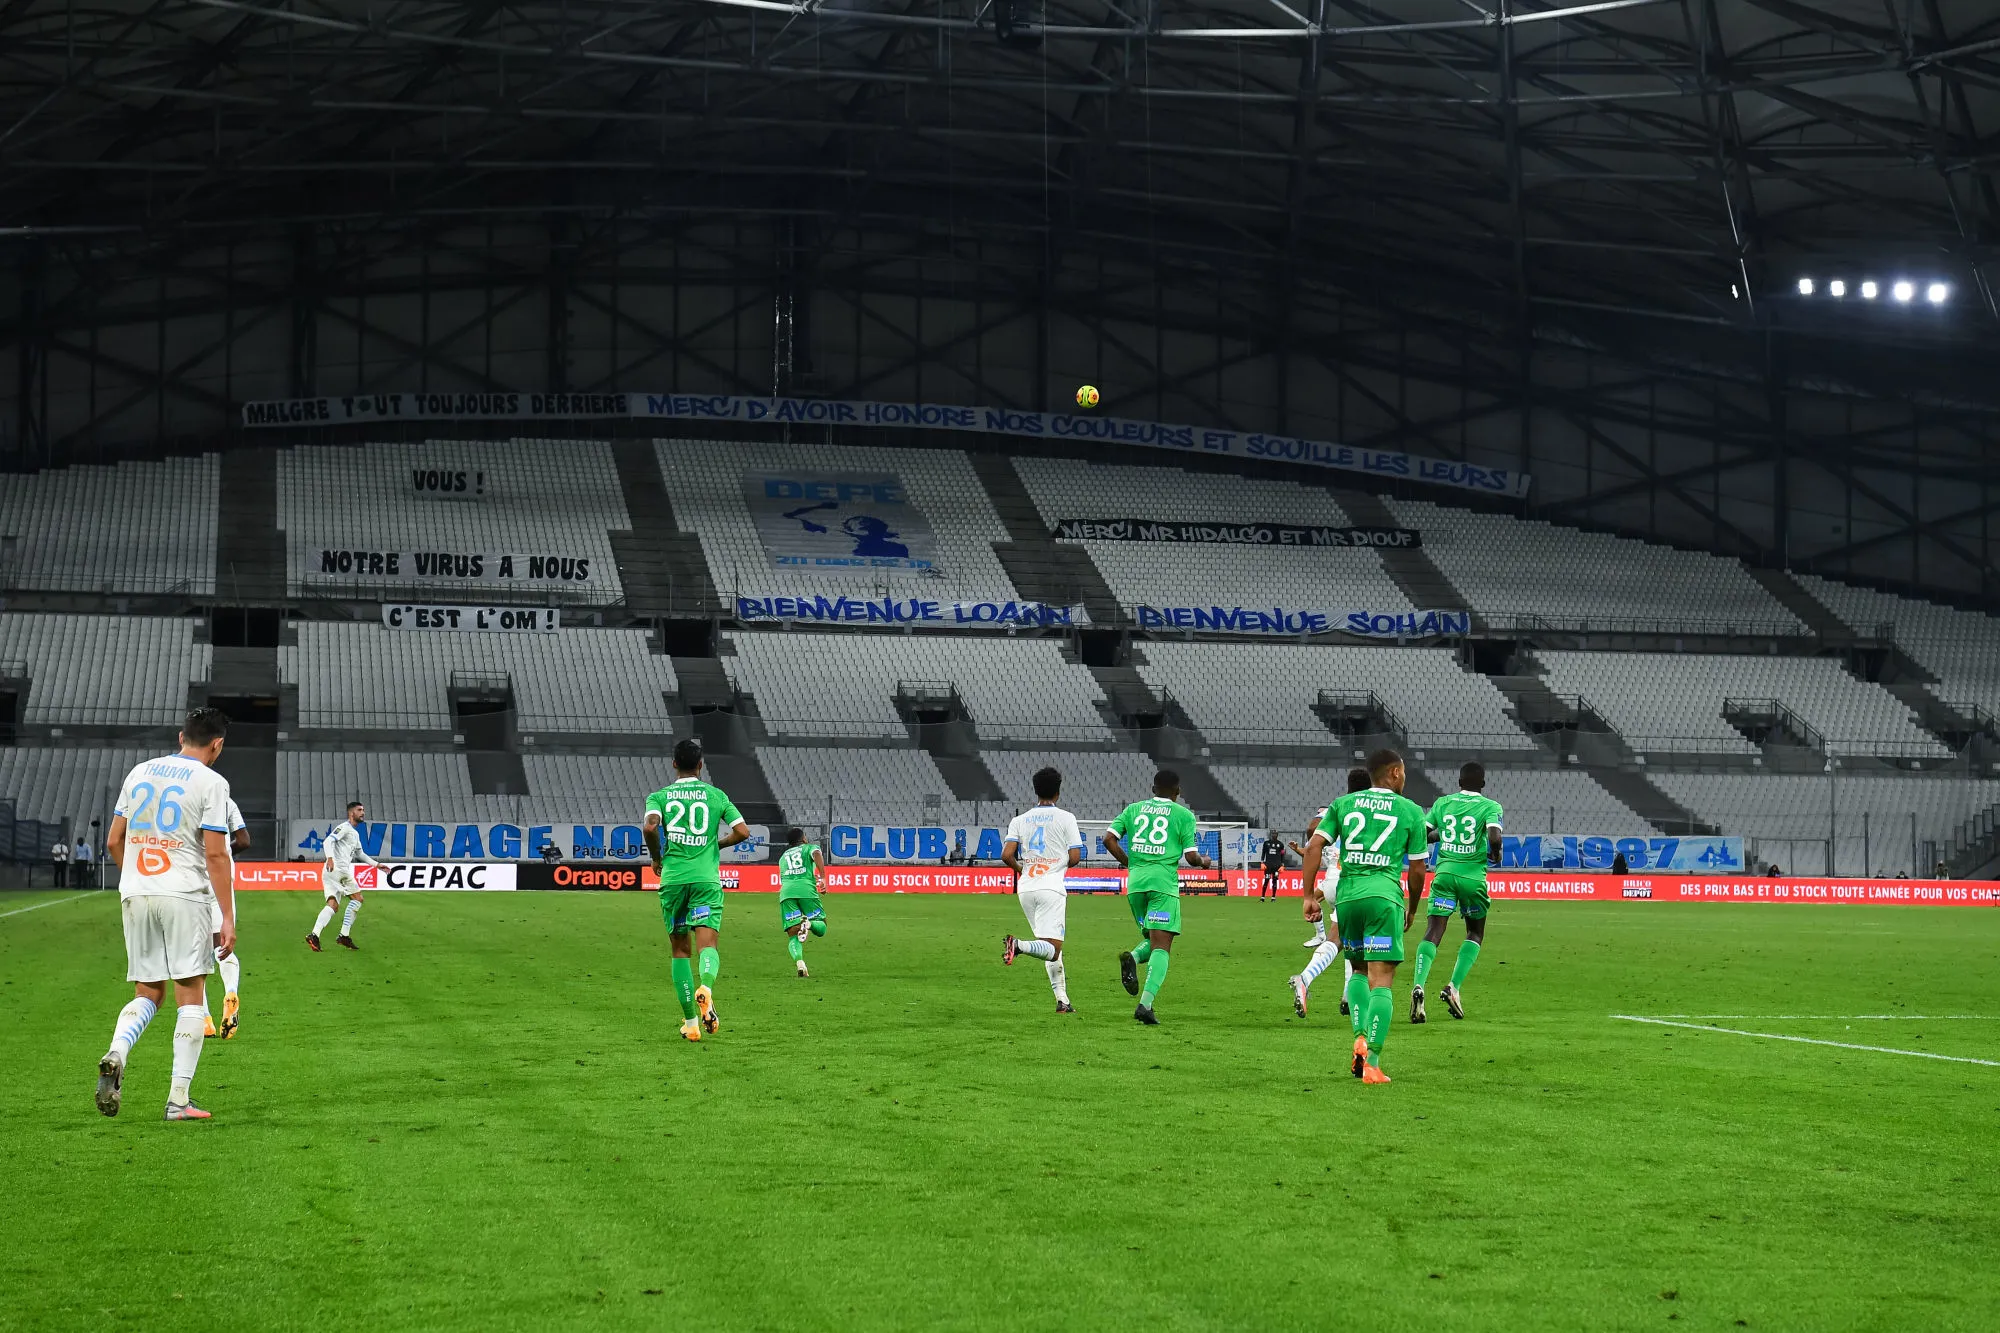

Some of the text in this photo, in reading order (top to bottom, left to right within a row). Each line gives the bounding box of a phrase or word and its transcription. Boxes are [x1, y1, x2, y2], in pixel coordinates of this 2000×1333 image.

[246, 399, 330, 423] MALGRE
[416, 394, 519, 415] TOUJOURS
[531, 393, 627, 414] DERRIERE
[647, 394, 739, 418] MERCI
[746, 398, 857, 422] D'AVOIR
[865, 402, 977, 427] HONORE
[986, 410, 1044, 434] NOS
[1052, 415, 1194, 448] COULEURS
[1203, 431, 1236, 450] ET
[1246, 432, 1354, 466] SOUILLE
[1363, 451, 1410, 475] LES
[1419, 460, 1507, 492] LEURS
[413, 470, 484, 494] VOUS !
[1060, 520, 1412, 548] MERCI MR HIDALGO ET MR DIOUF
[322, 551, 590, 581] NOTRE VIRUS A NOUS
[389, 606, 555, 630] C'EST L'OM !
[738, 595, 1070, 625] BIENVENUE LOANN
[1137, 605, 1469, 635] BIENVENUE SOHAN
[144, 763, 194, 781] THAUVIN
[129, 782, 185, 833] 26
[666, 790, 708, 801] BOUANGA
[1354, 798, 1393, 812] MAÇON
[665, 800, 710, 836] 20
[1131, 814, 1169, 845] 28
[1441, 814, 1477, 845] 33
[357, 822, 553, 859] VIRAGE
[831, 825, 948, 860] CLUB
[1029, 826, 1047, 855] 4
[1343, 811, 1399, 852] 27
[573, 844, 626, 857] Patrice
[784, 850, 804, 870] 18
[1344, 851, 1391, 867] AFFLELOU
[1440, 841, 1477, 854] AFFLELOU
[1563, 836, 1679, 869] 1987
[1022, 856, 1060, 866] oulanger
[239, 870, 318, 882] ULTRA
[386, 865, 488, 890] CEPAC
[553, 865, 637, 890] Orange
[828, 873, 1014, 888] BAS ET DU STOCK TOUTE L'ANNÉ
[1486, 881, 1595, 894] OUR VOS CHANTIERS
[1680, 884, 1701, 895] DES
[1704, 884, 1730, 896] PRIX
[1733, 885, 1754, 896] BAS
[1758, 885, 1771, 896] ET
[1774, 885, 1790, 897] DU
[1793, 885, 1828, 897] STOCK
[1831, 886, 1865, 898] TOUTE
[1868, 885, 1910, 899] L'ANNÉE
[1914, 887, 1943, 899] POUR
[1946, 888, 1968, 899] VOS
[1369, 1014, 1380, 1043] ASSE
